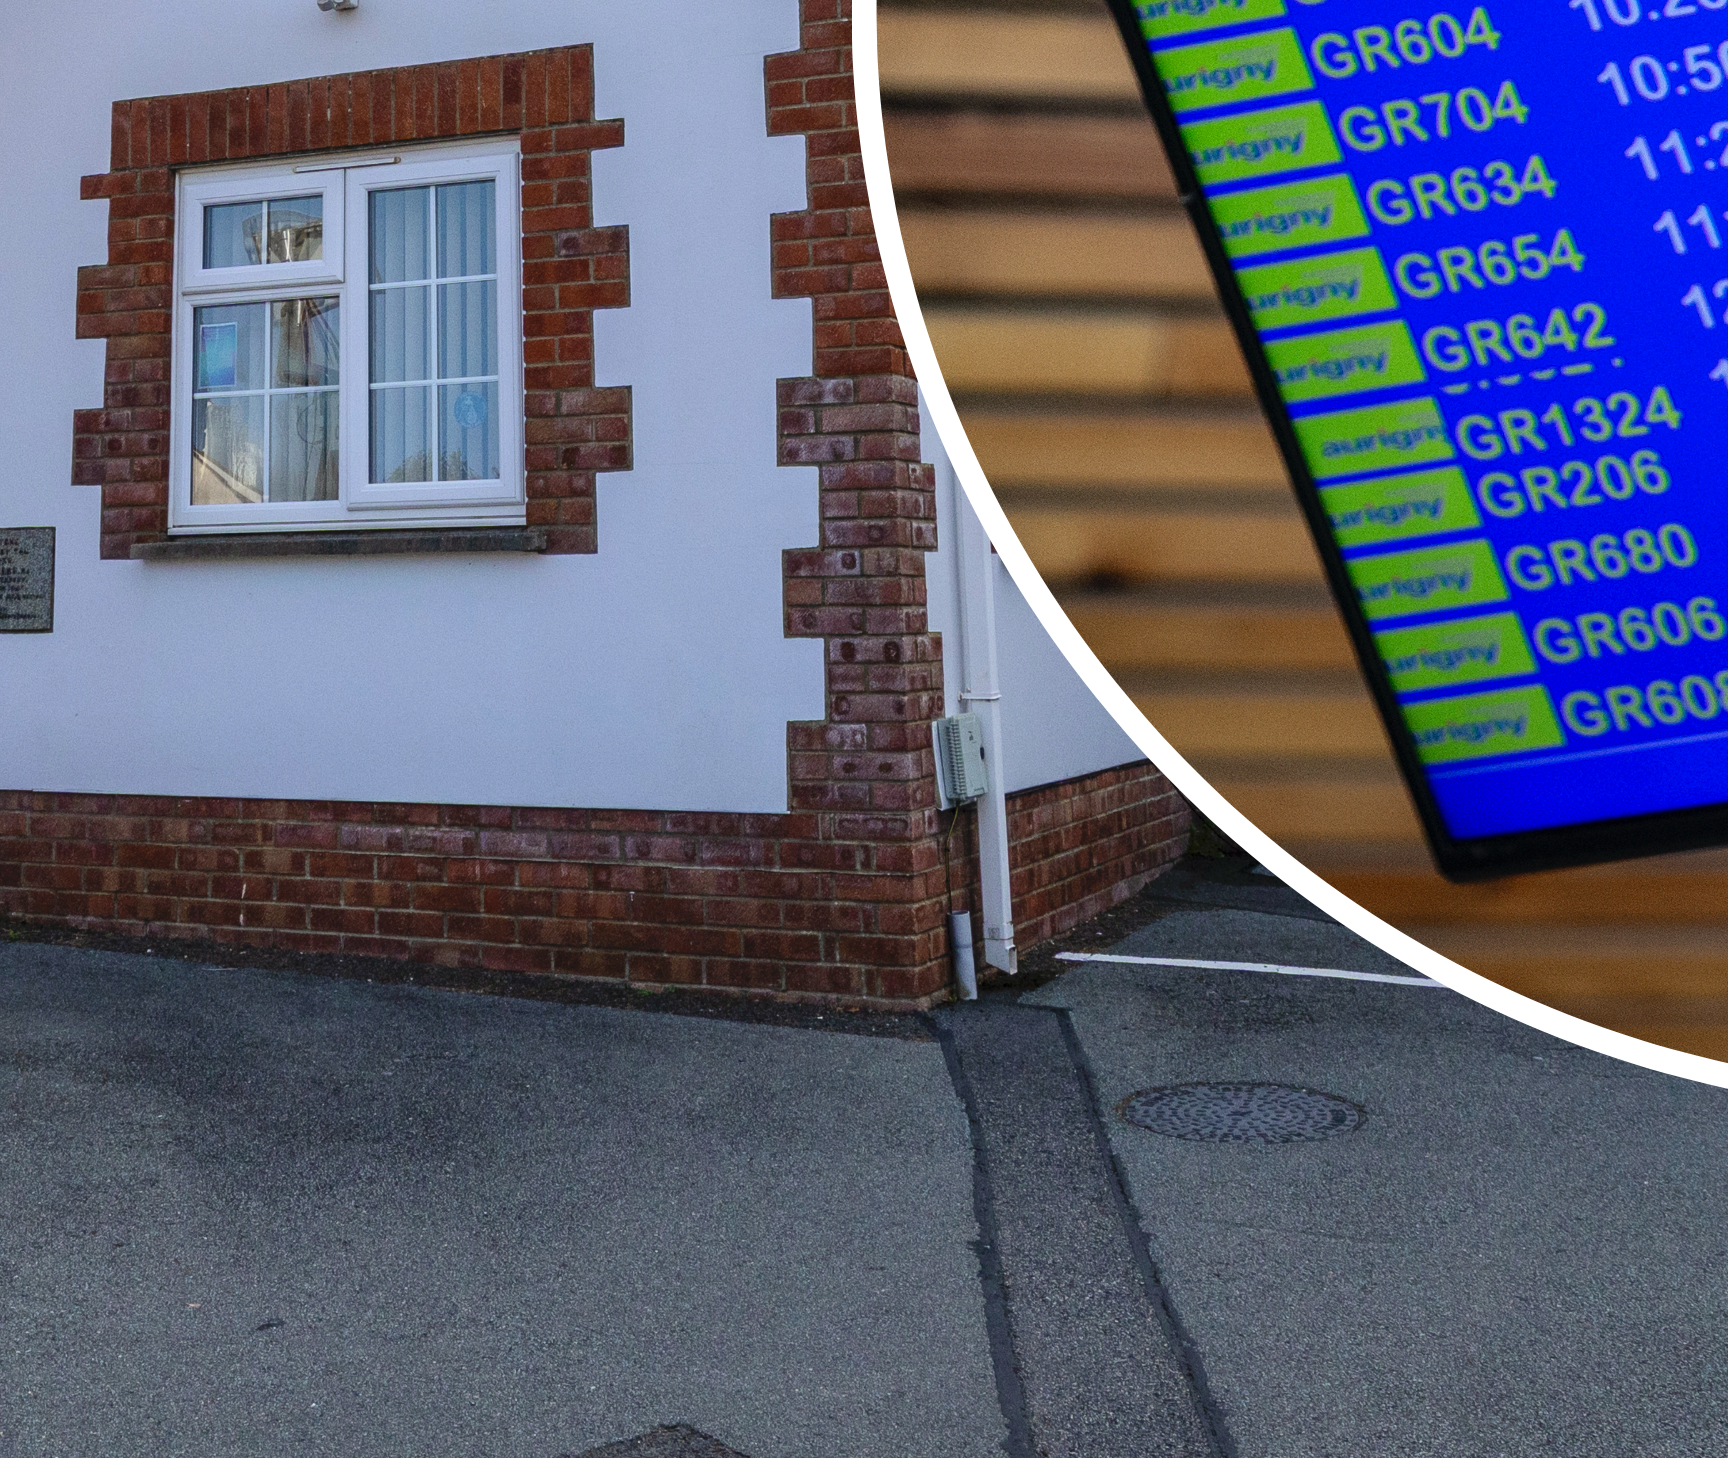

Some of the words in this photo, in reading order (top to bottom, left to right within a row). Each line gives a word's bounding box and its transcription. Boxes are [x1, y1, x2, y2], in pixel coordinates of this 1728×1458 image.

[1311, 7, 1501, 80] GR604
[1338, 81, 1529, 153] GR704
[1366, 155, 1556, 226] GR634
[1394, 229, 1584, 299] GR654
[1422, 302, 1615, 372] GR642
[1455, 386, 1682, 460] GR1324
[1477, 449, 1671, 519] GR206
[1504, 523, 1699, 592] GR680
[1533, 597, 1727, 664] GR606
